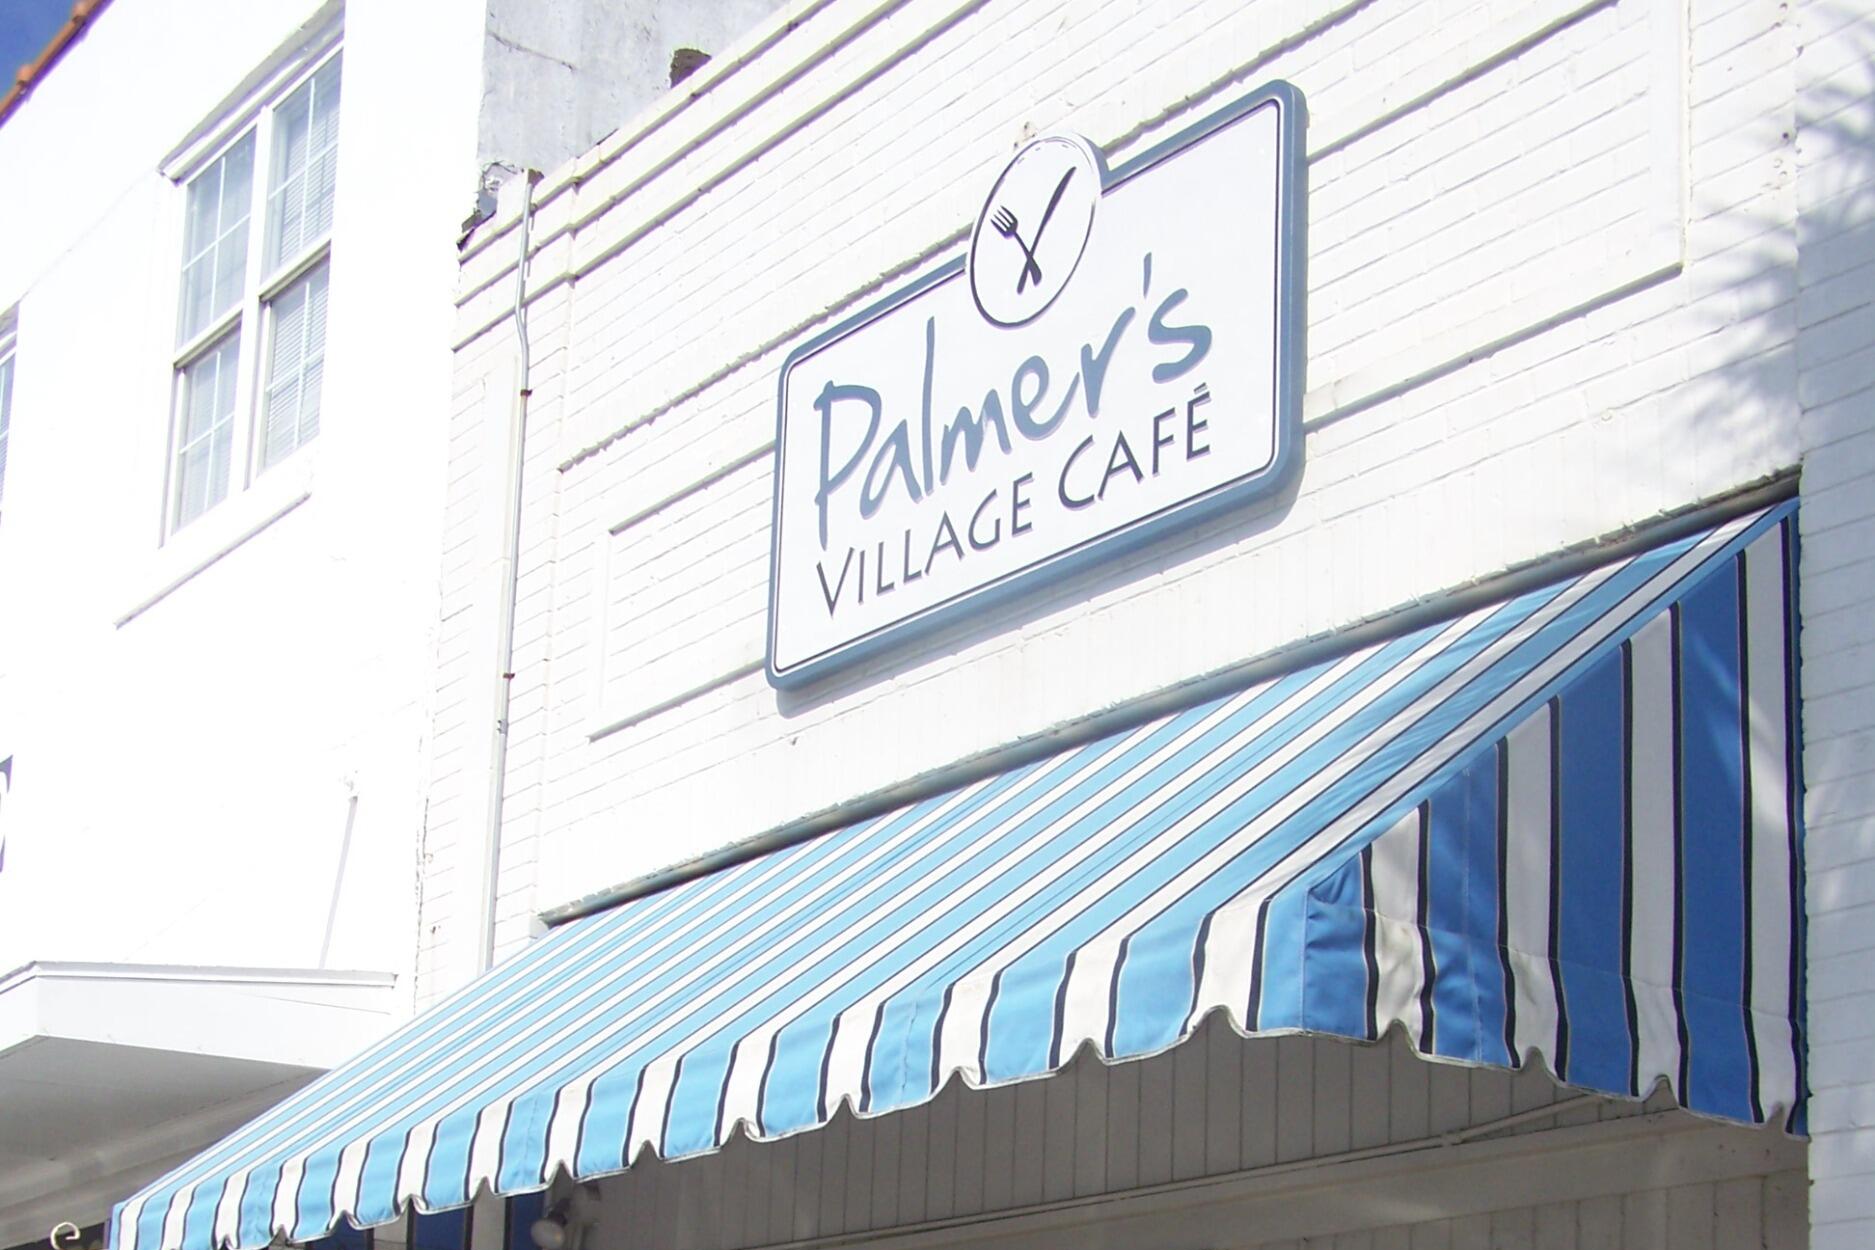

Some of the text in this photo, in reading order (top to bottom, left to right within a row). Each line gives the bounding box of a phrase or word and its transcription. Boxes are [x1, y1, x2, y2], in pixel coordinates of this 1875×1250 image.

[813, 251, 1213, 551] Palmer's
[815, 381, 1212, 617] VILLAGE CAFÉ
